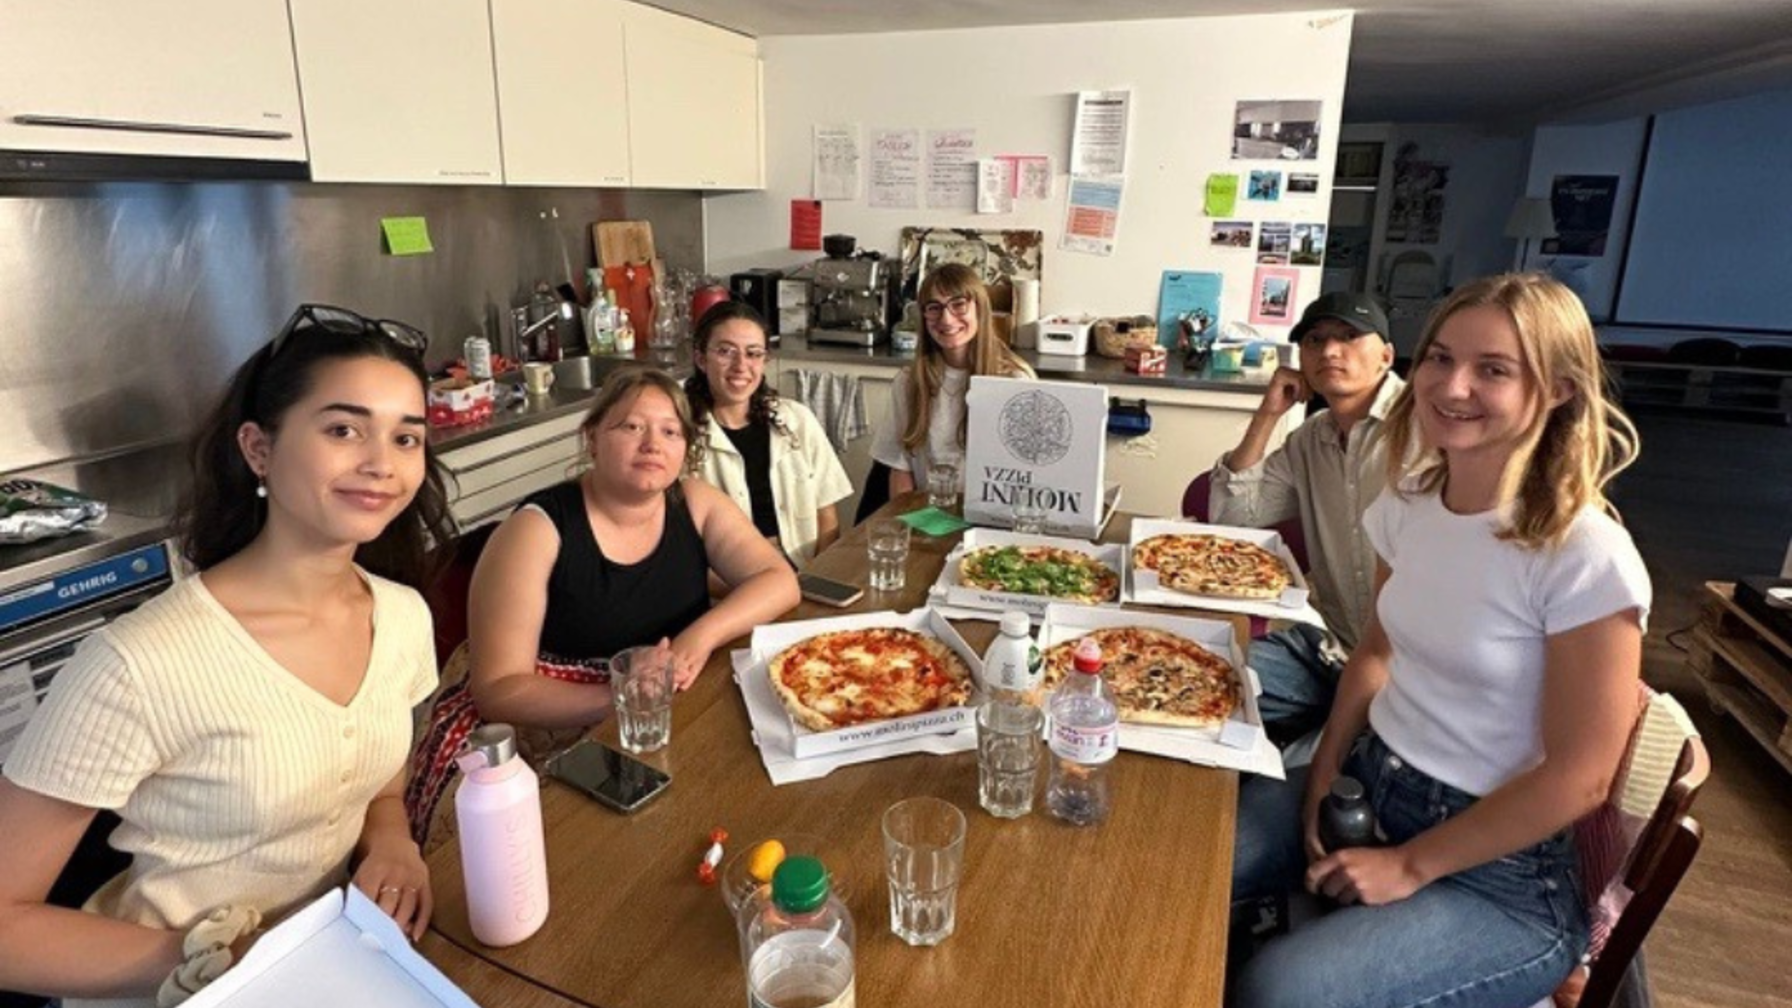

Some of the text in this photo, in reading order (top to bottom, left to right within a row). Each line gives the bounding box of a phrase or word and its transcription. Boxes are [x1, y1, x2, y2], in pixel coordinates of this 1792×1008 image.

[984, 466, 1031, 484] PIZZA
[981, 481, 1081, 513] MOLINI
[58, 571, 117, 598] GEHRIG
